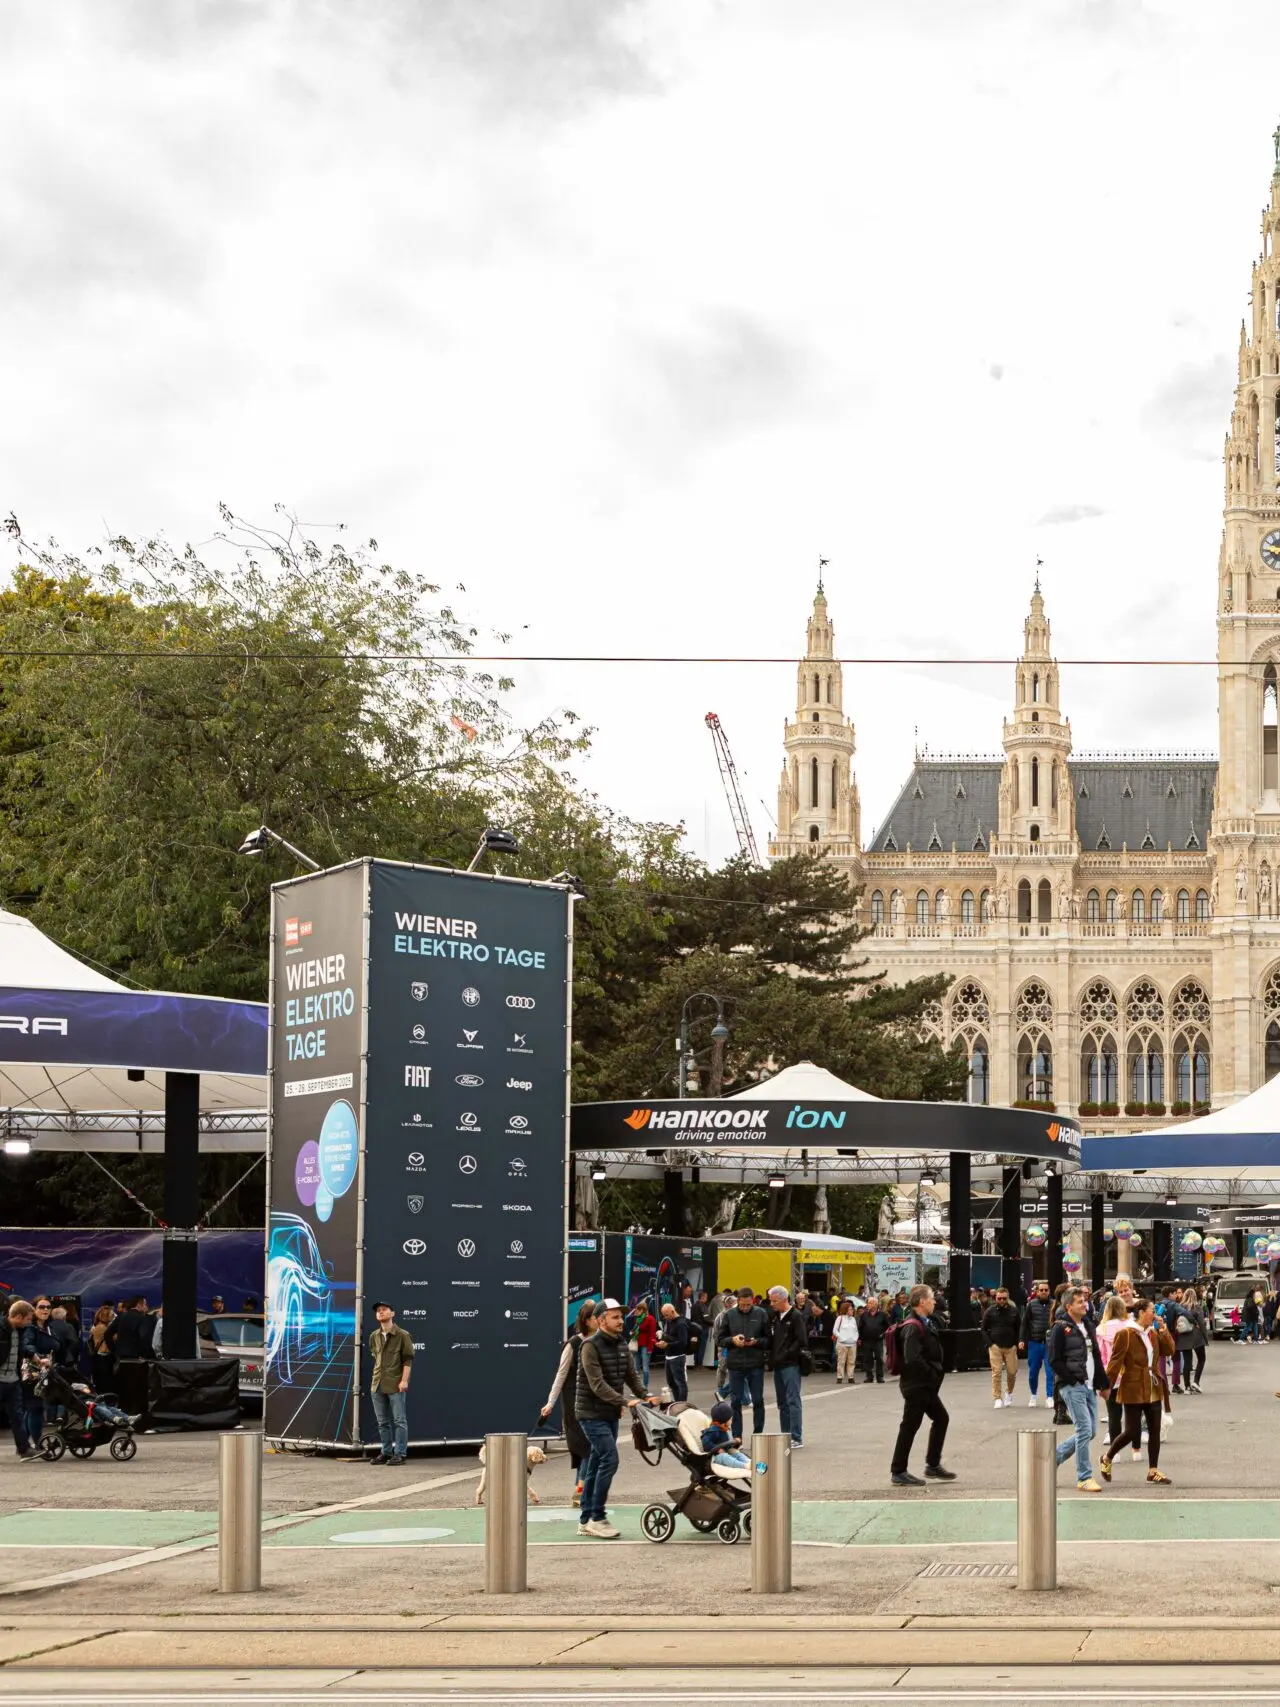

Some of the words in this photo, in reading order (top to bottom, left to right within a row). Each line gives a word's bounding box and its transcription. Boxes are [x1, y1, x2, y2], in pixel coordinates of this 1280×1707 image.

[394, 912, 477, 939] WIENER
[394, 935, 489, 962] ELEKTRO
[494, 946, 546, 969] TAGE
[286, 954, 345, 992] WIENER
[286, 988, 354, 1027] ELEKTRO
[286, 1029, 326, 1061] TAGE
[307, 1079, 338, 1093] SEPTEMBER
[405, 1065, 432, 1087] FIAT
[506, 1078, 532, 1091] Jeep
[674, 1130, 714, 1142] driving
[717, 1130, 766, 1140] emotion
